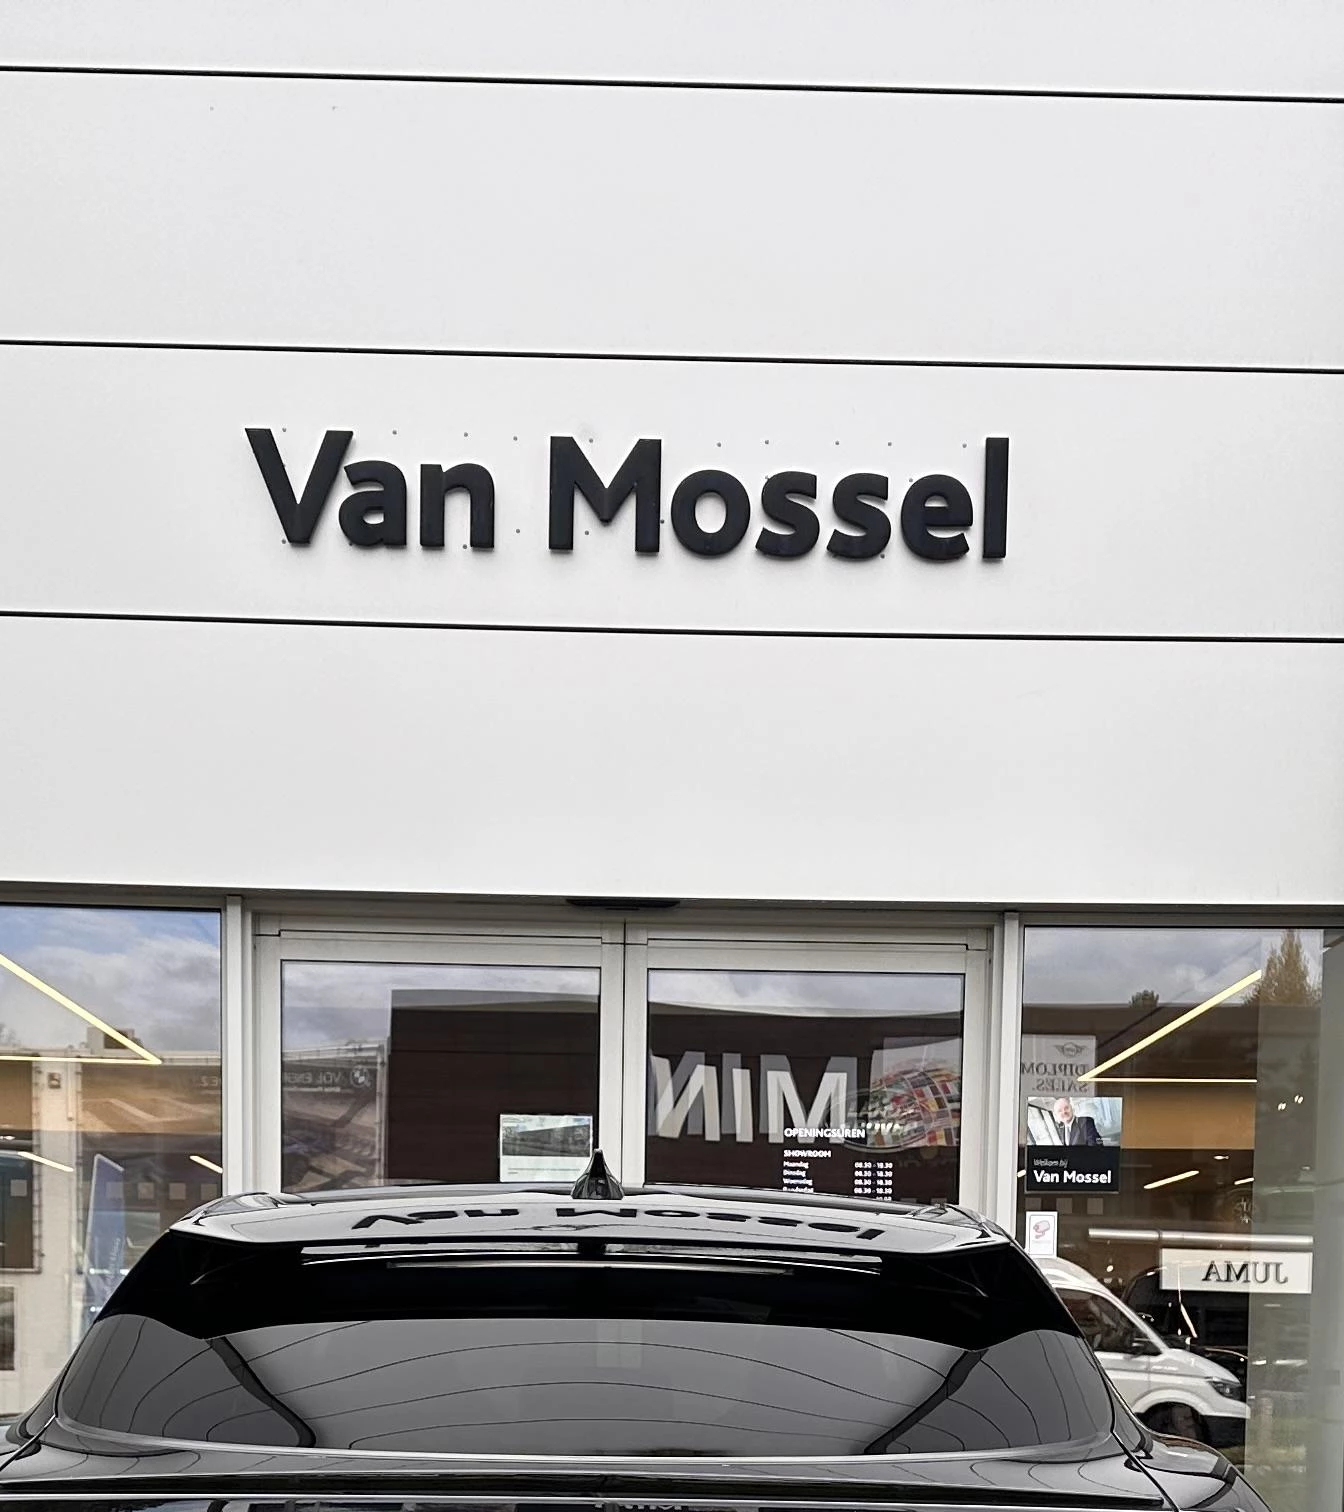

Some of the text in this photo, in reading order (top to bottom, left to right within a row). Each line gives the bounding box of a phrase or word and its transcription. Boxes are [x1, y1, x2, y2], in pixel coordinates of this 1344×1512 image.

[244, 428, 1010, 560] Van Mossel
[784, 1128, 866, 1138] OPENINGSUREN
[783, 1150, 832, 1158] SHOWROOM
[1033, 1170, 1112, 1183] Van Mossel
